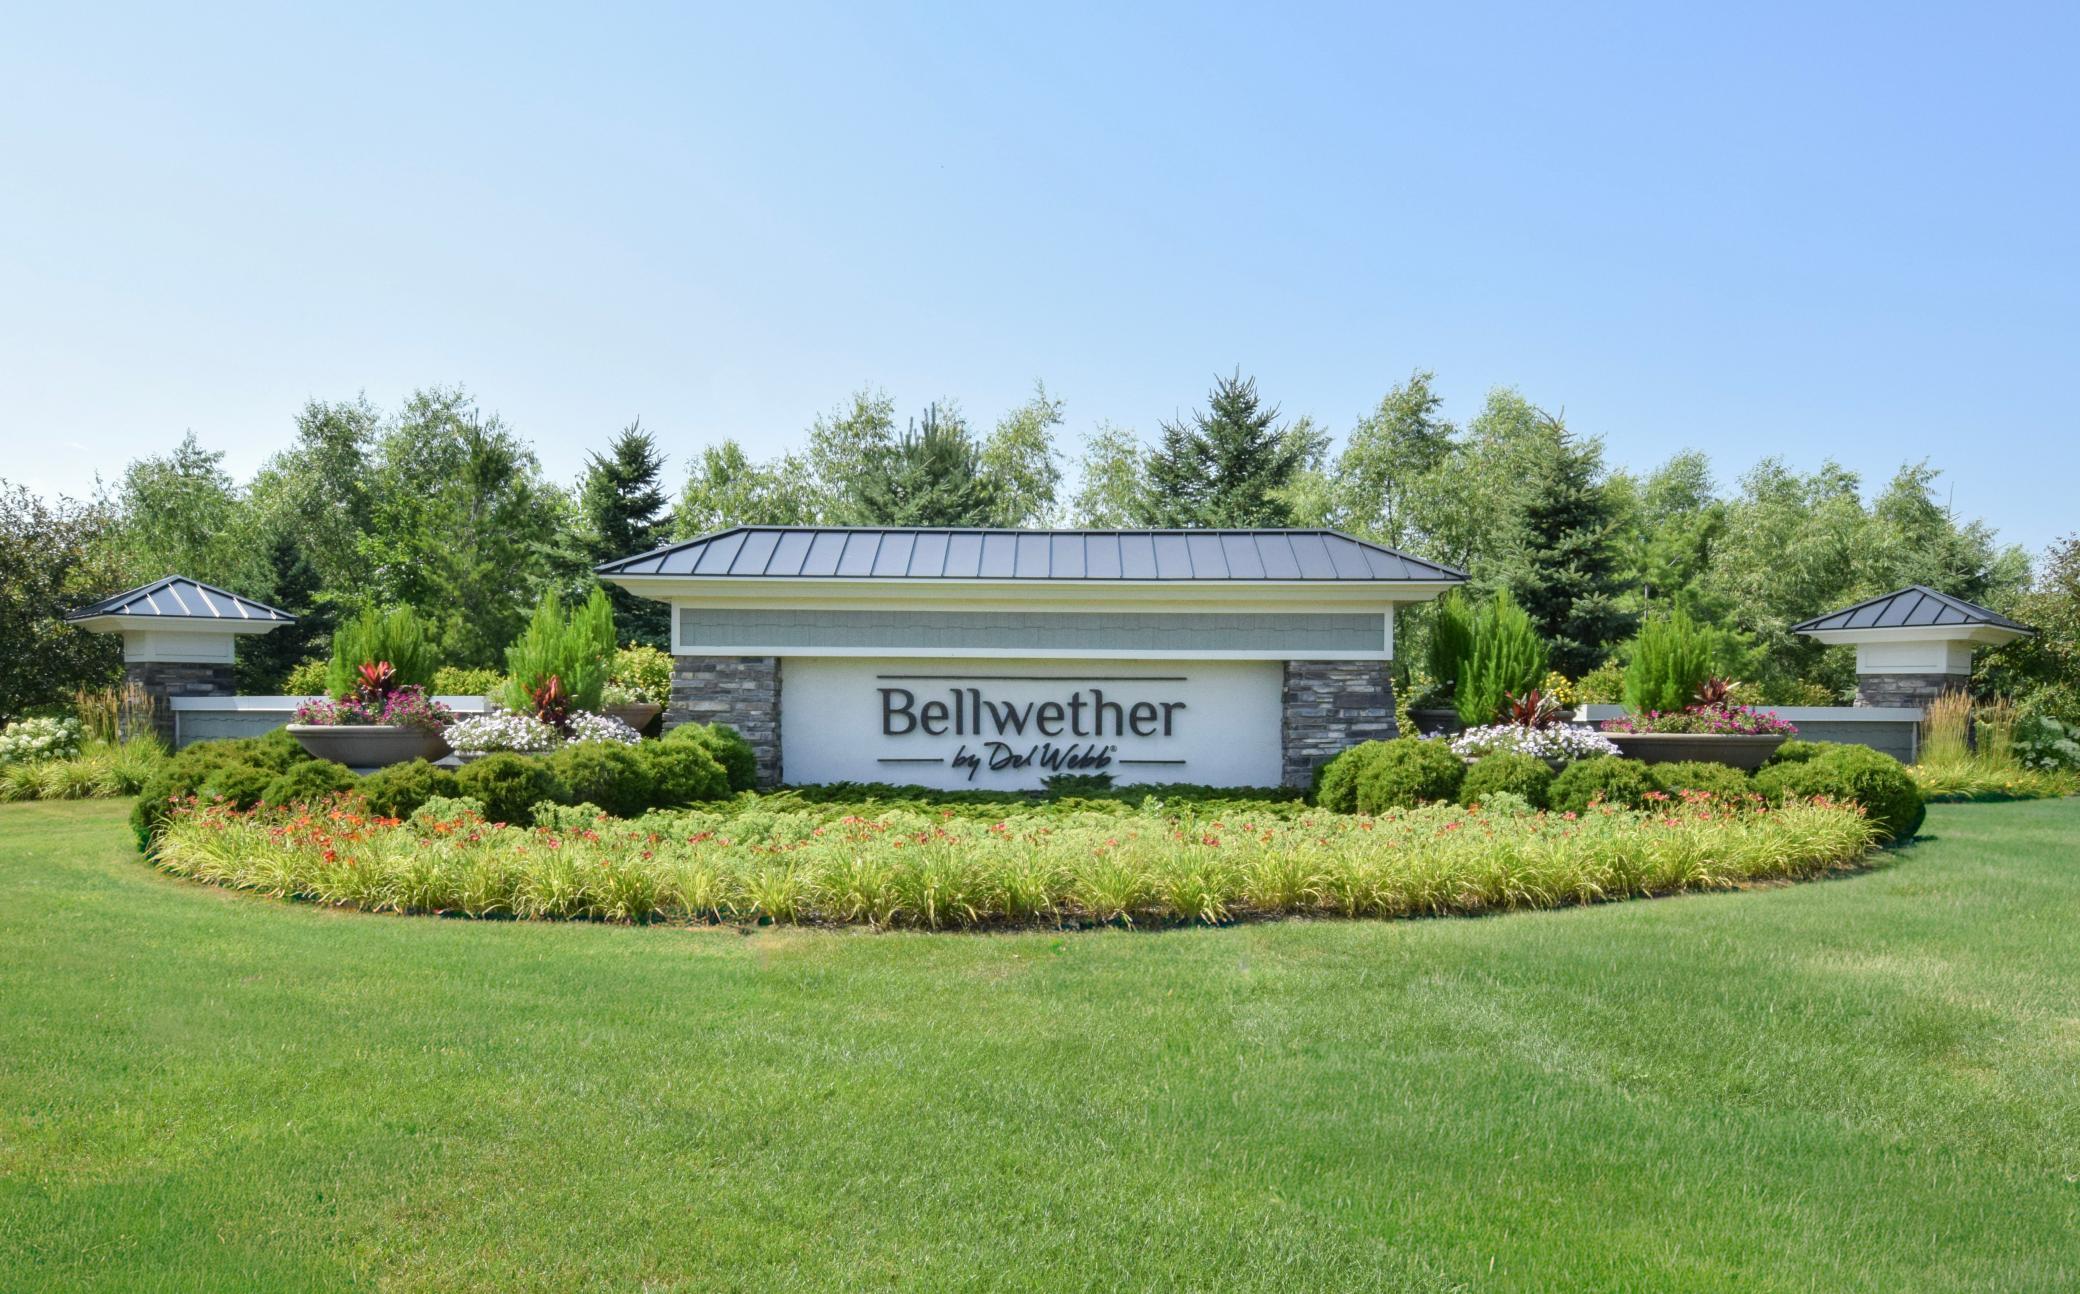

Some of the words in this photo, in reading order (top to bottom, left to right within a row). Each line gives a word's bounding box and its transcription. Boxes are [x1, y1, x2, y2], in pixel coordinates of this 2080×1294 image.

[877, 687, 1187, 736] Bellwether
[951, 744, 981, 781] by
[984, 741, 1039, 771] Del
